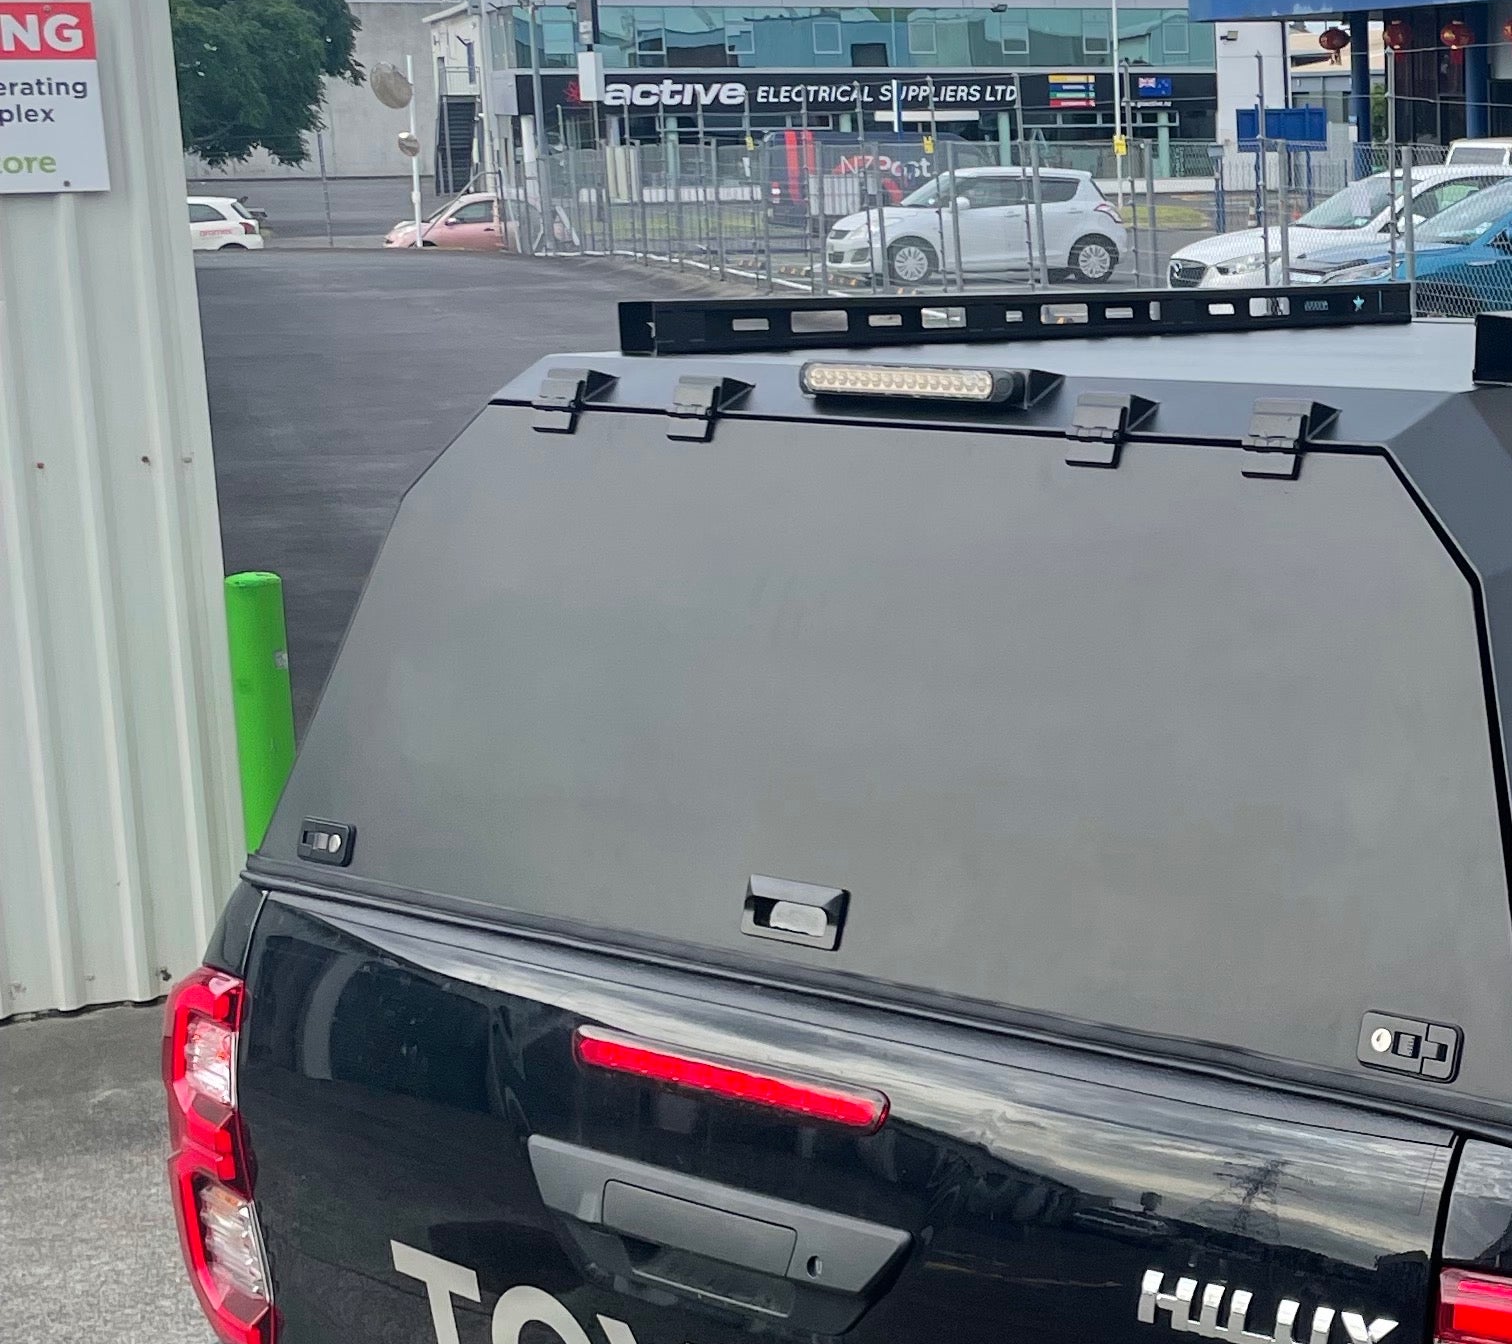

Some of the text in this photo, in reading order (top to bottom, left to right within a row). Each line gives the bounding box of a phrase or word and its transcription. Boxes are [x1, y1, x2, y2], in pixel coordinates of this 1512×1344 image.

[0, 13, 84, 53] NG
[603, 78, 746, 107] active
[756, 85, 874, 103] ELECTRICAL
[984, 84, 1018, 102] LTD
[0, 155, 57, 174] ore
